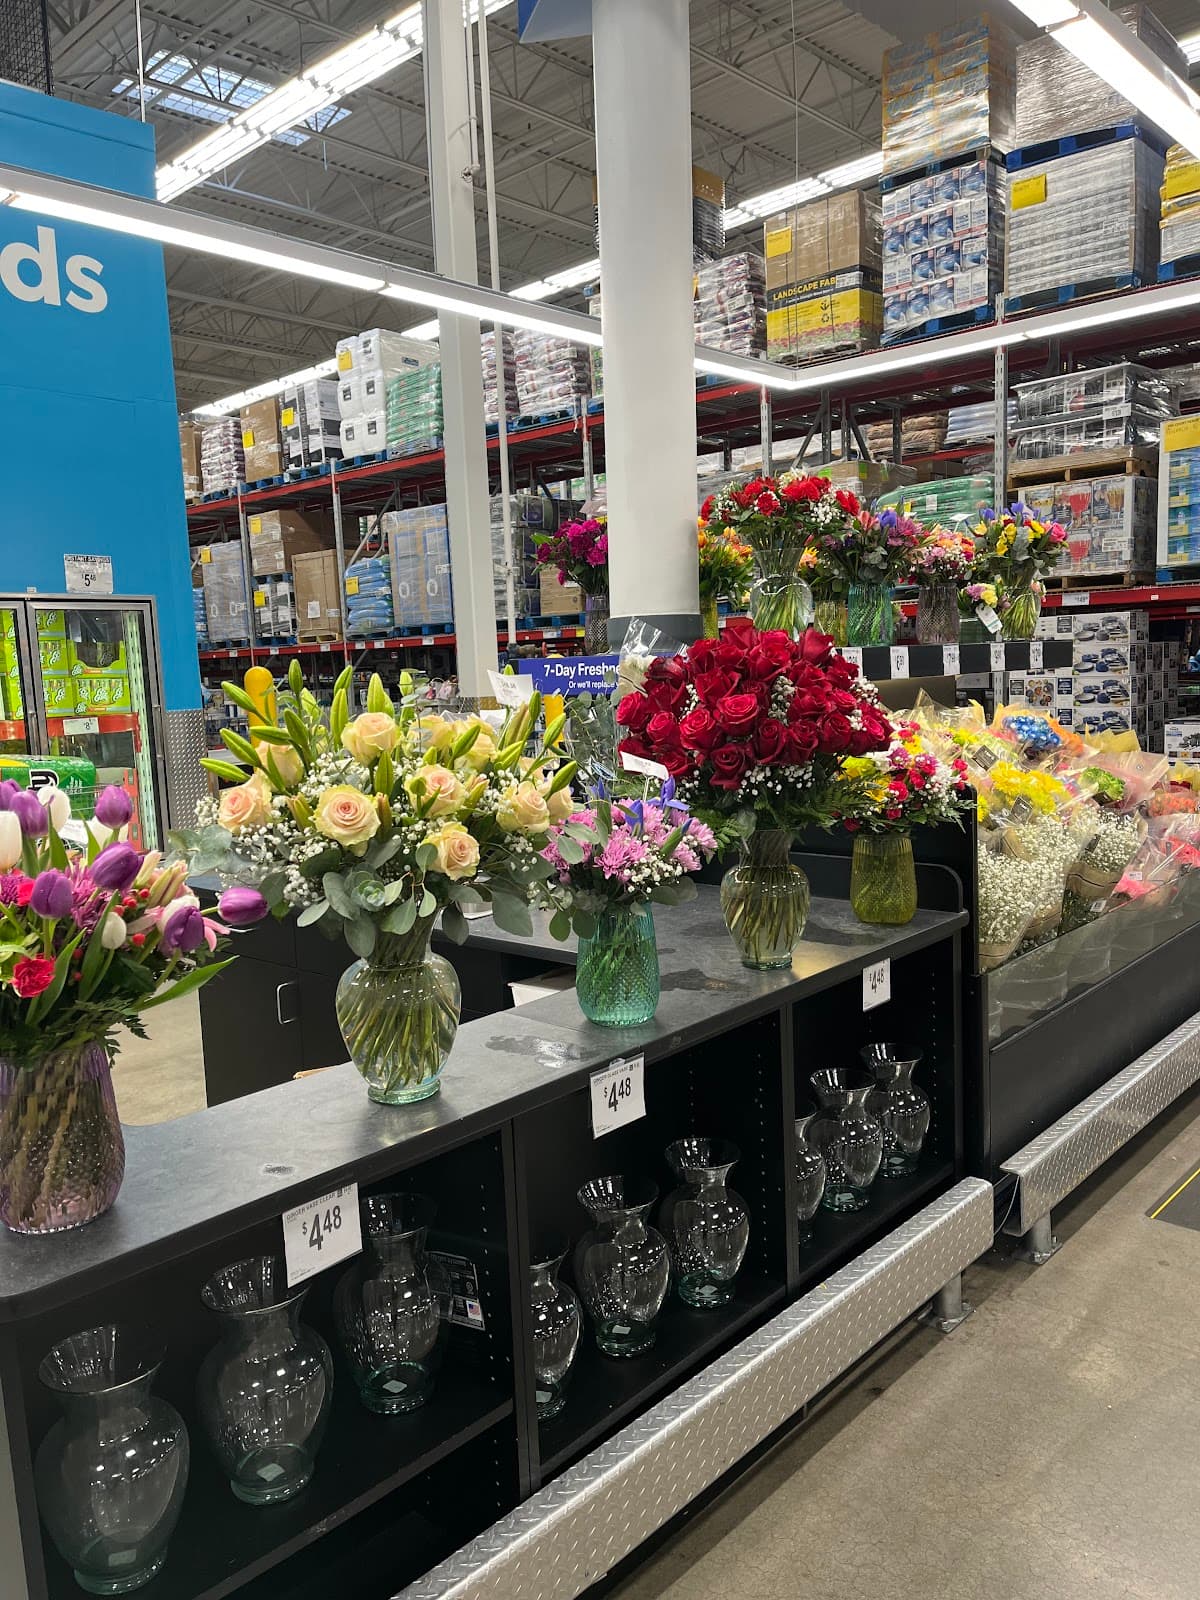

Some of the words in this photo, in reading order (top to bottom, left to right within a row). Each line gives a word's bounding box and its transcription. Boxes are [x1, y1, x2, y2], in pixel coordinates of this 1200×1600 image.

[773, 280, 819, 301] LANDSCAPE
[544, 664, 576, 679] 7-Day
[568, 681, 577, 689] Or
[577, 680, 591, 689] we'll
